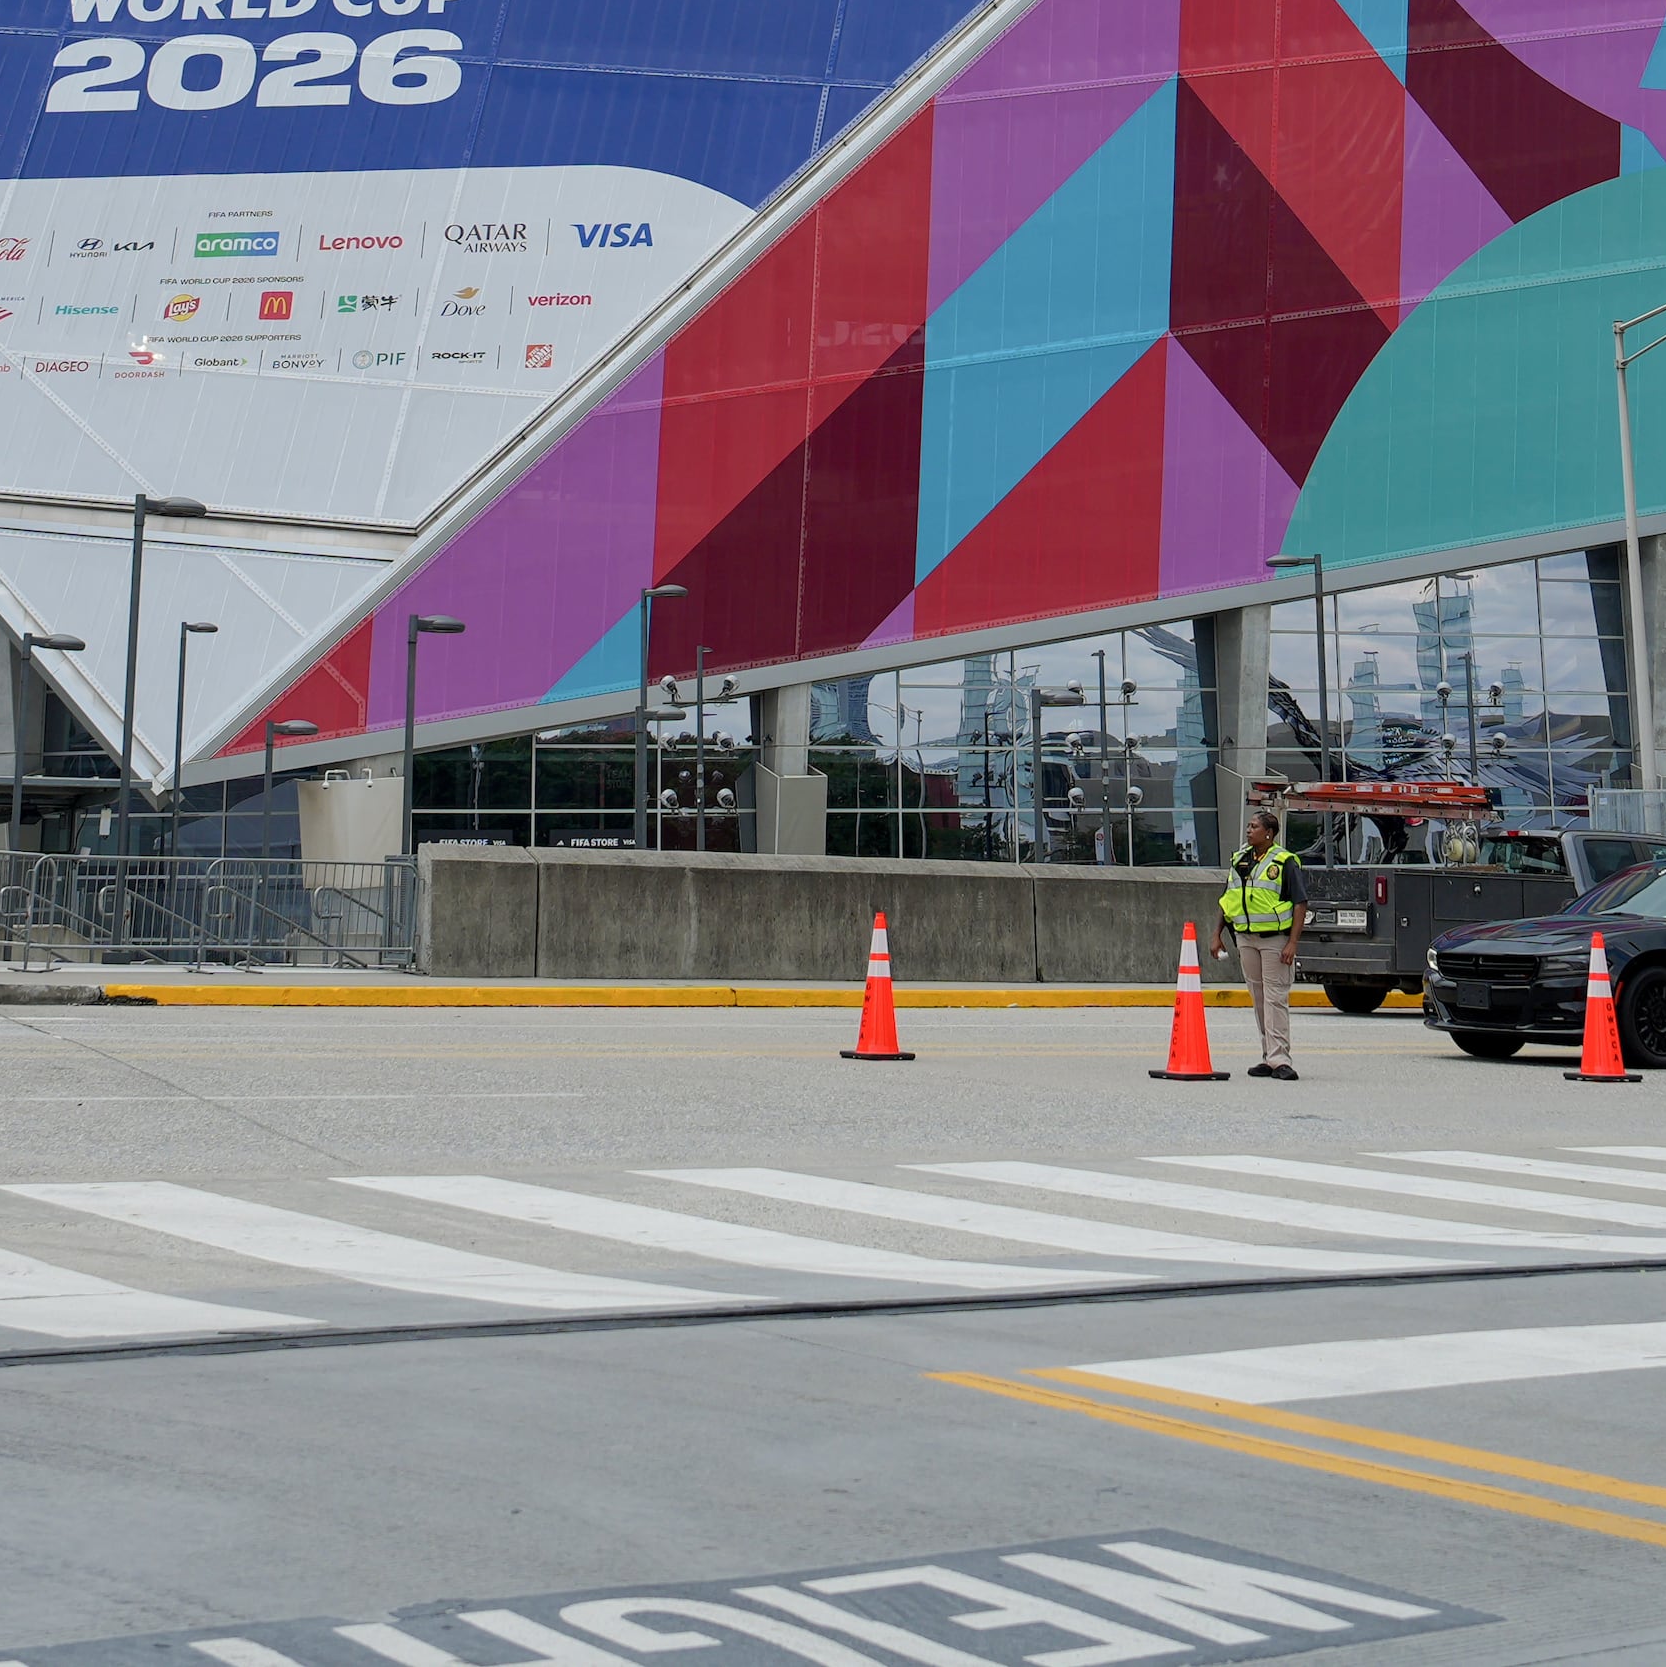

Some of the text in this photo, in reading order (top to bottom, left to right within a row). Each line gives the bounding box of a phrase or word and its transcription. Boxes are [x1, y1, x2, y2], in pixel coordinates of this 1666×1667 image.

[45, 29, 464, 113] 2026
[228, 210, 273, 218] PARTNERS
[444, 223, 527, 245] QATAR
[570, 223, 653, 248] VISA
[197, 237, 277, 252] aramco
[319, 235, 403, 250] Lenovo
[464, 241, 527, 253] AIRWAYS
[212, 277, 230, 285] CUP
[528, 292, 592, 306] verizon
[55, 305, 119, 316] Hisense
[441, 301, 485, 317] Dove
[200, 335, 219, 343] CUP
[245, 334, 302, 342] SUPPORTERS
[194, 357, 239, 367] Globant
[377, 352, 406, 366] PIF
[35, 361, 89, 373] DIAGEO
[114, 371, 165, 379] DOORDASH
[571, 839, 590, 847] FIFA
[590, 839, 619, 847] STORE
[188, 1541, 1441, 1667] WEIGH
